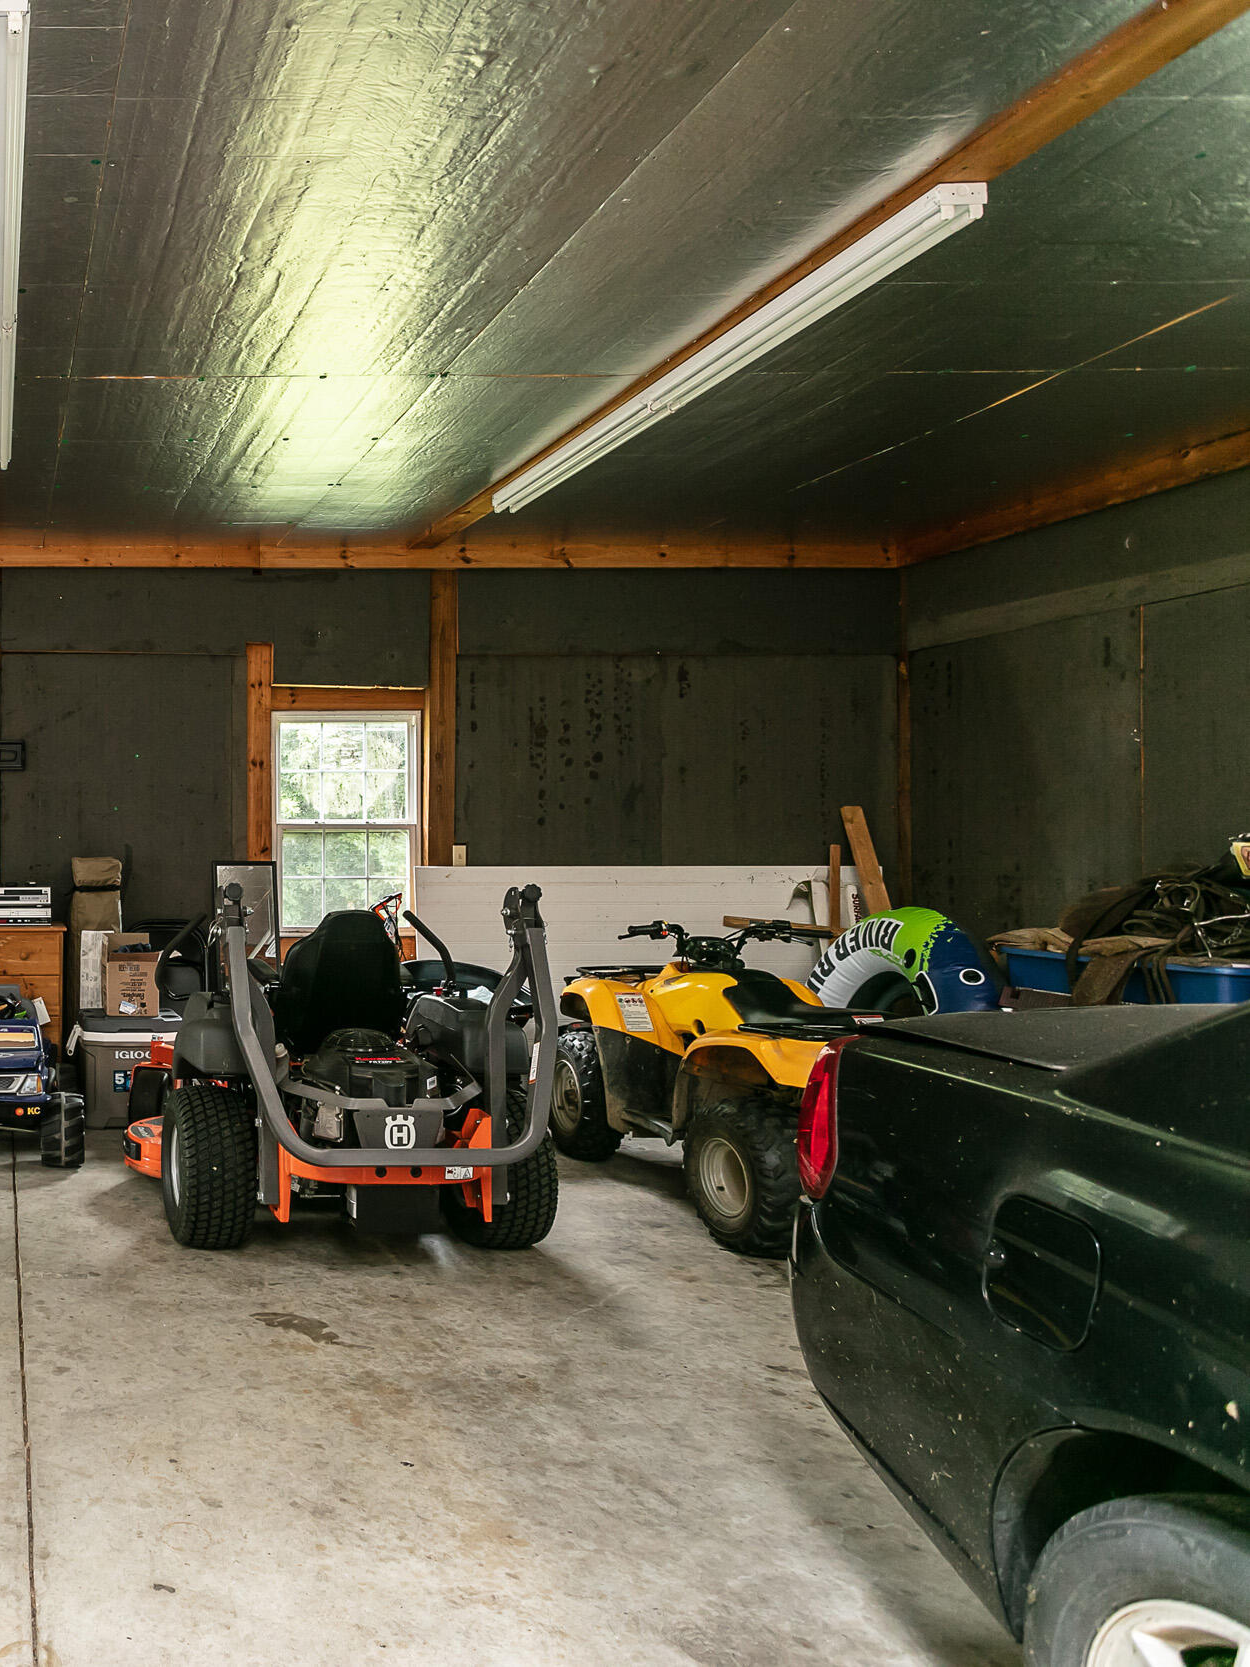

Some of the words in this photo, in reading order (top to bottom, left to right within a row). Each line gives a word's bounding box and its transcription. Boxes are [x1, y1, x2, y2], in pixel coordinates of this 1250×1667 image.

[851, 893, 862, 924] SURFA
[834, 919, 903, 961] RIVER
[806, 952, 836, 995] RU
[27, 1107, 41, 1115] KC
[392, 1126, 408, 1144] H
